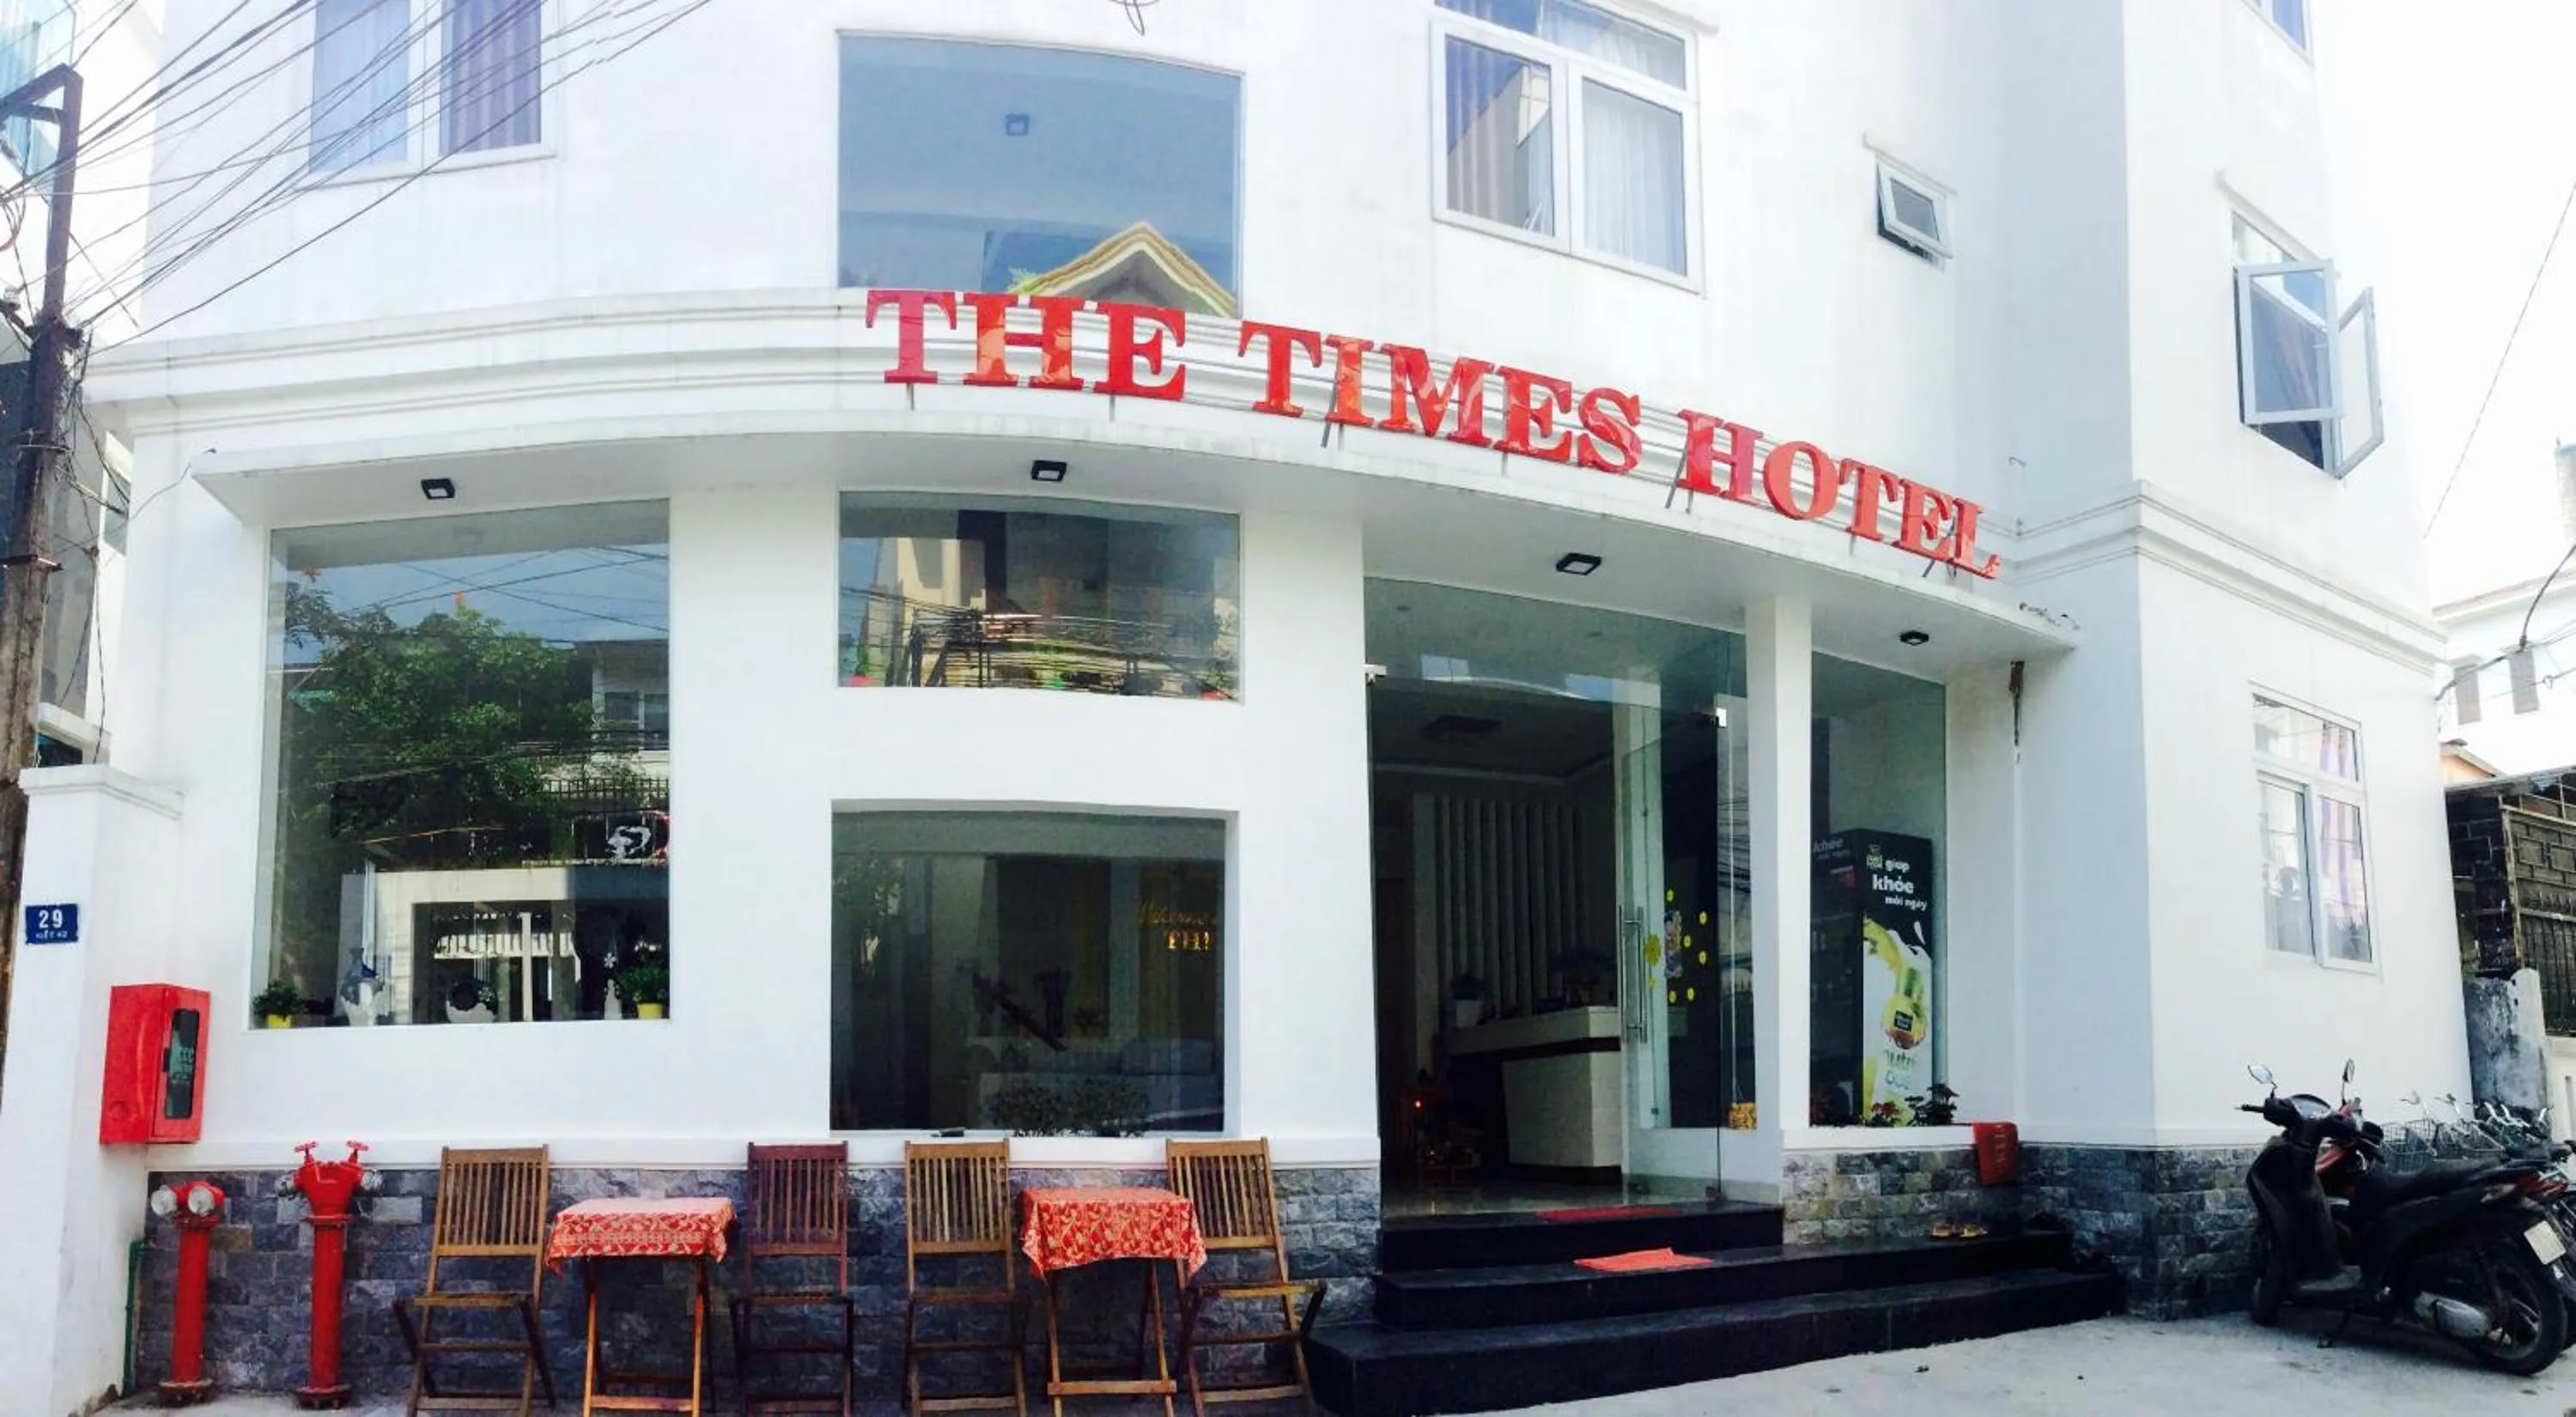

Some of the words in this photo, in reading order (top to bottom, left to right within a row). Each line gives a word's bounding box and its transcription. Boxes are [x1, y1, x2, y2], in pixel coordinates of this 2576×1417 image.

[865, 289, 1186, 402] THE
[1237, 320, 1642, 475] TIMES
[1676, 409, 2001, 580] HOTEL
[38, 909, 64, 929] 29
